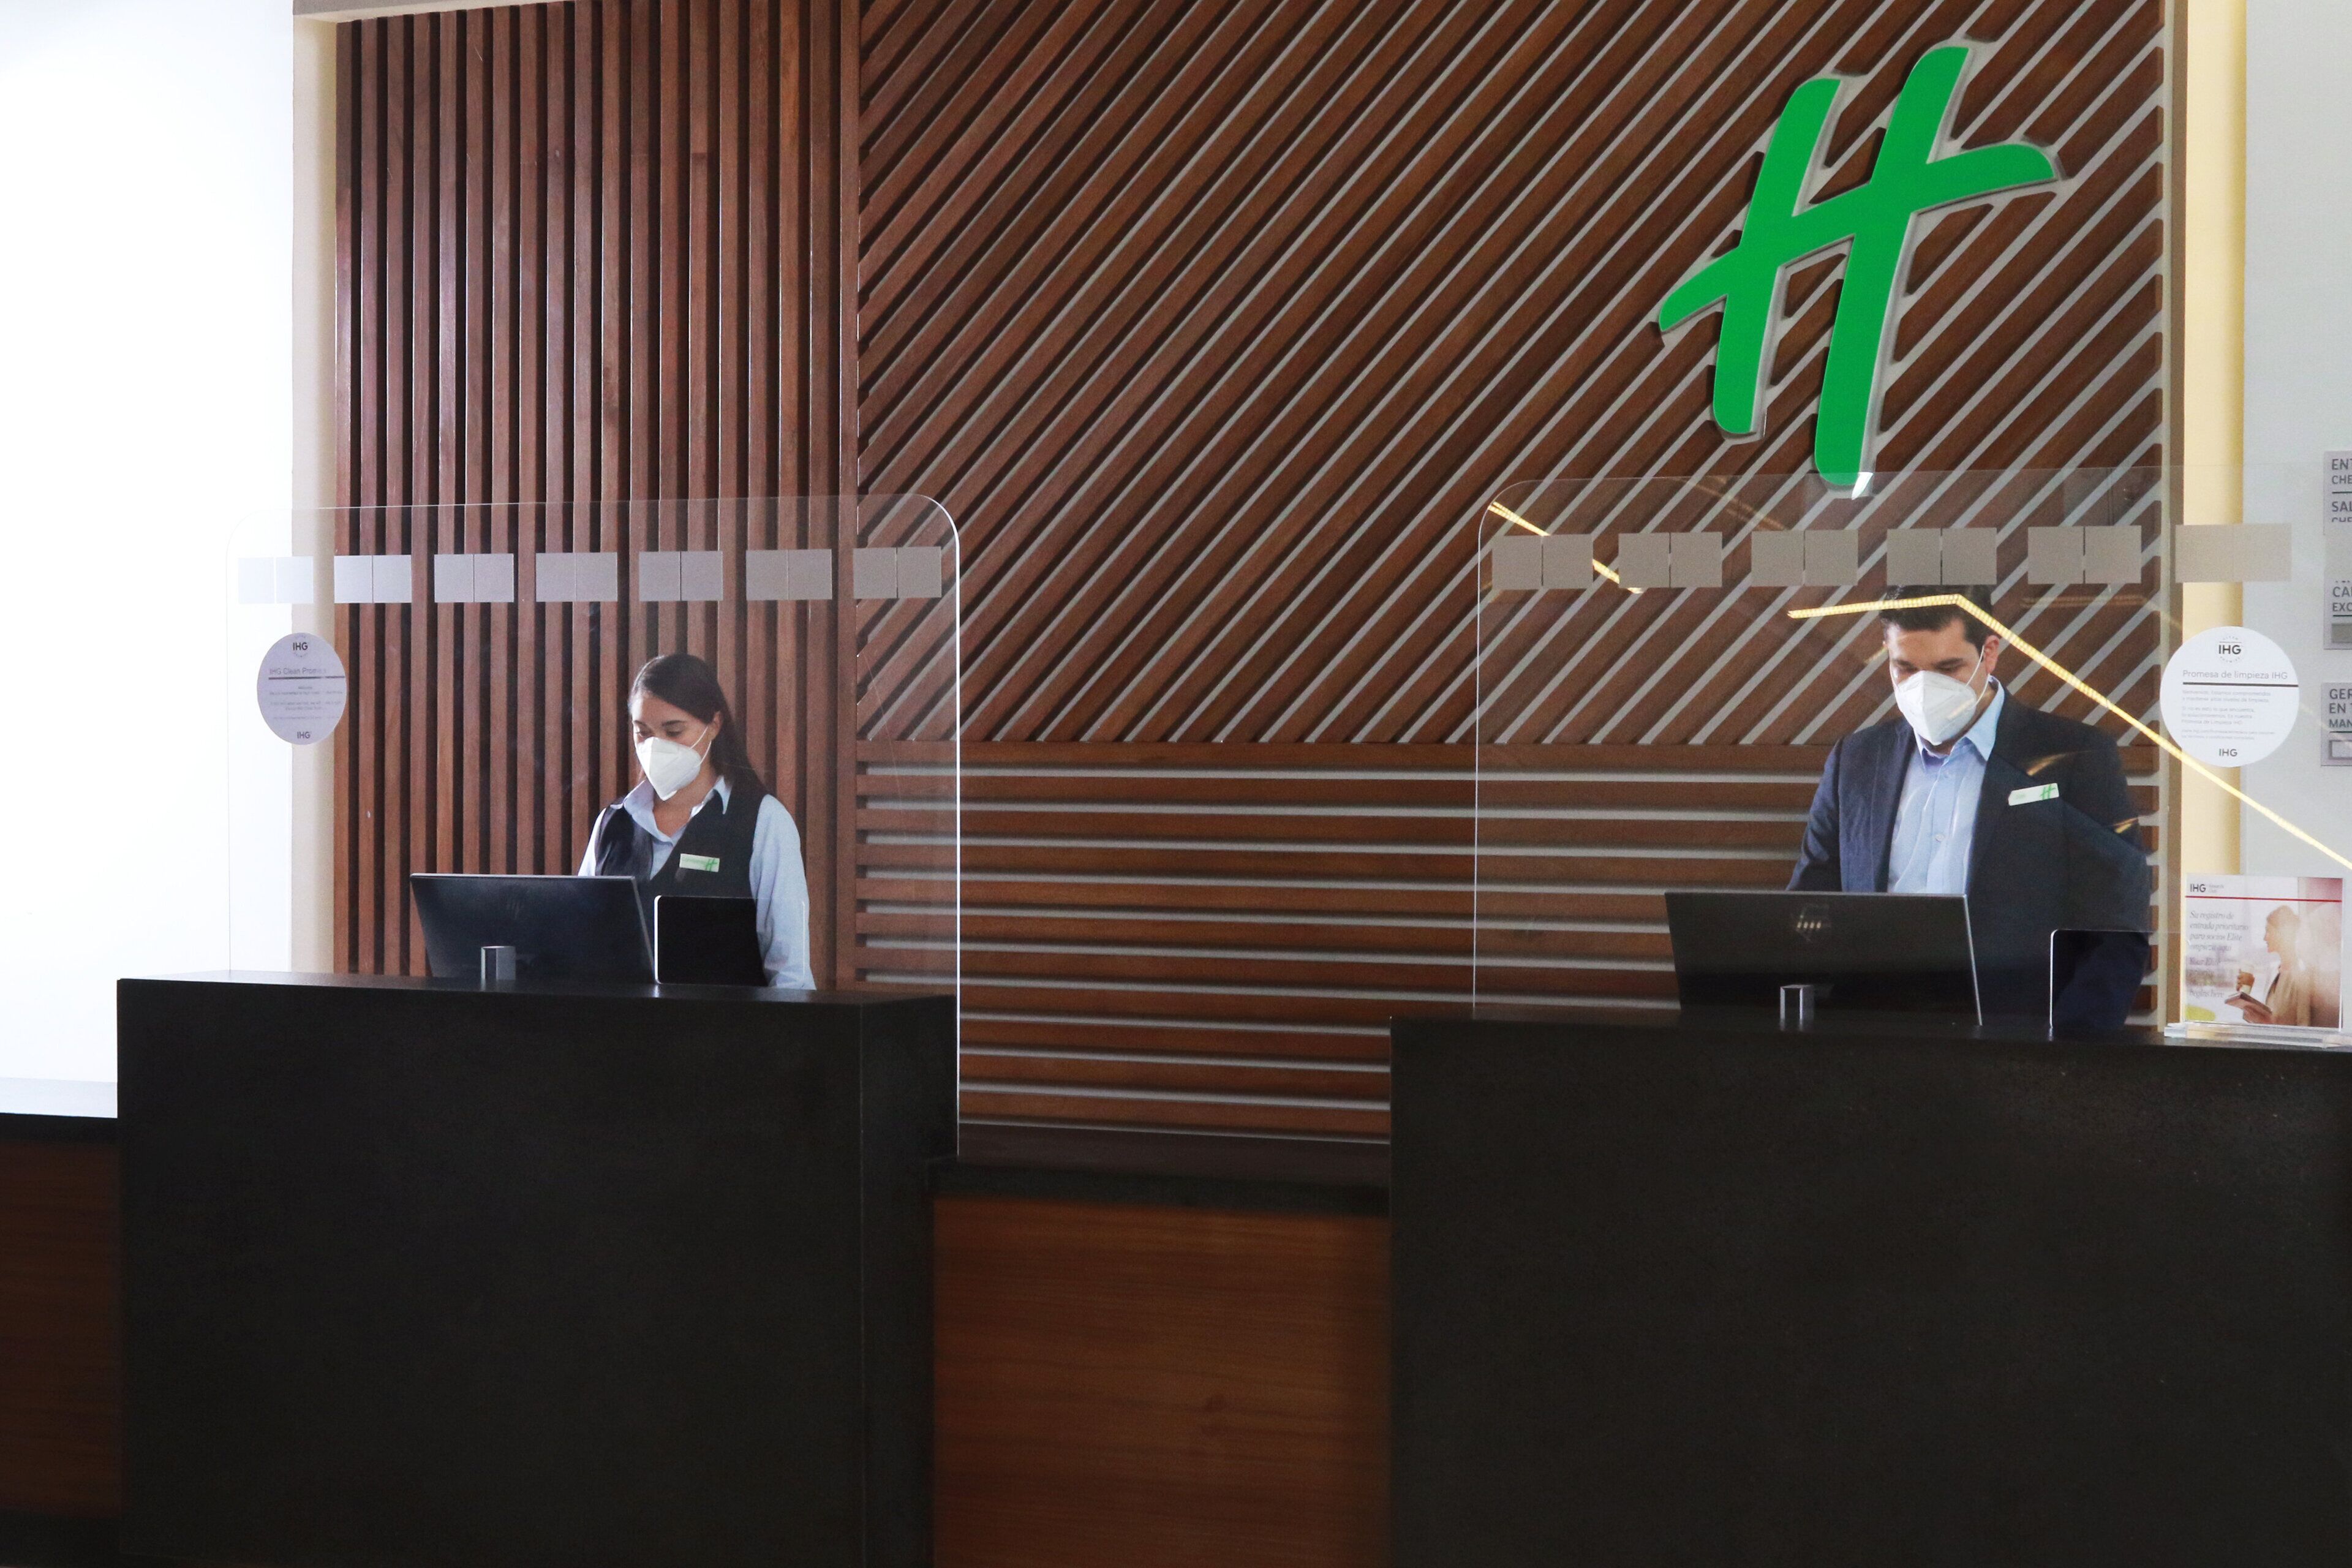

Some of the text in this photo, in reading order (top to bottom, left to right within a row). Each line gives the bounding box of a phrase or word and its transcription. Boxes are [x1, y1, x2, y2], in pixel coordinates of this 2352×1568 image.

[2333, 586, 2352, 597] CA
[293, 642, 308, 650] IHG
[2218, 644, 2242, 655] IHG
[2234, 671, 2269, 680] limpieza
[2329, 703, 2346, 714] EN
[2218, 748, 2238, 757] IHG
[2190, 884, 2206, 892] IHG
